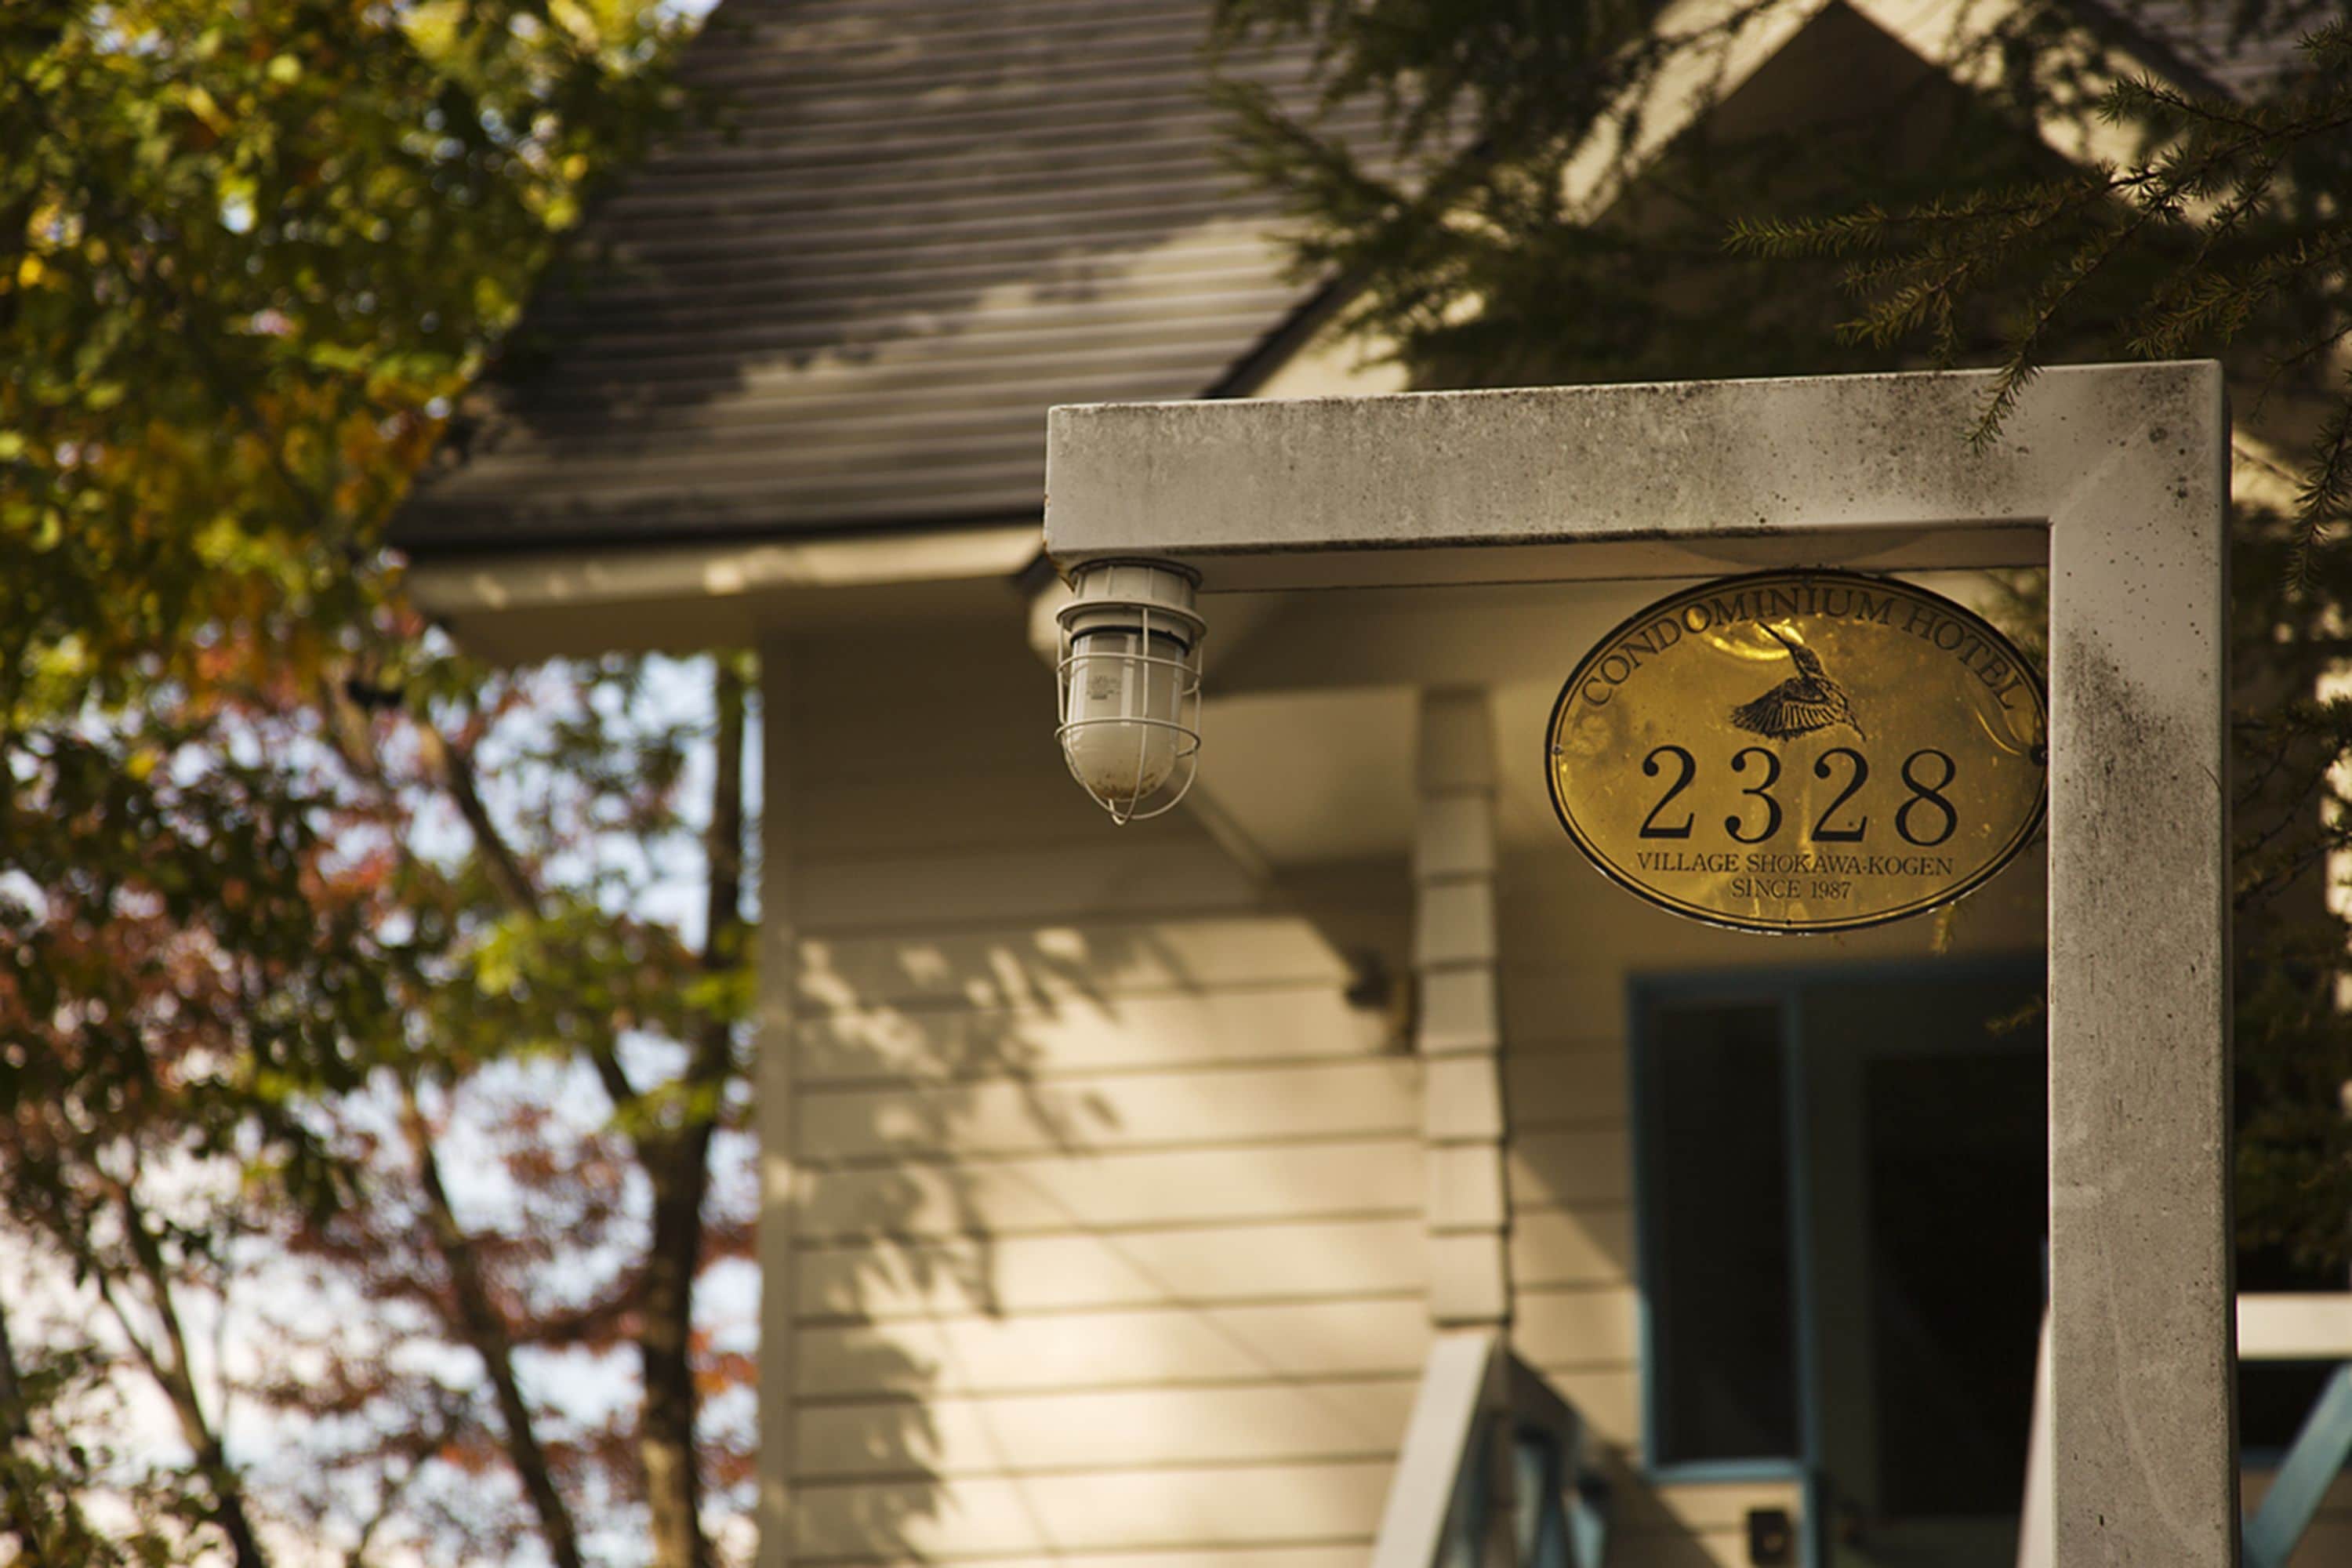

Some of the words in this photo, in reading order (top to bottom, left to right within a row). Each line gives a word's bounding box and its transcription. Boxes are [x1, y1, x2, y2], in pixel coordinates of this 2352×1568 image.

[1581, 587, 1896, 706] CONDOMINIUM
[1900, 604, 2023, 710] HOTEL
[1639, 745, 1958, 847] 2328
[1637, 852, 1740, 873] VILLAGE
[1731, 879, 1802, 899] SINCE
[1811, 880, 1852, 900] 1987
